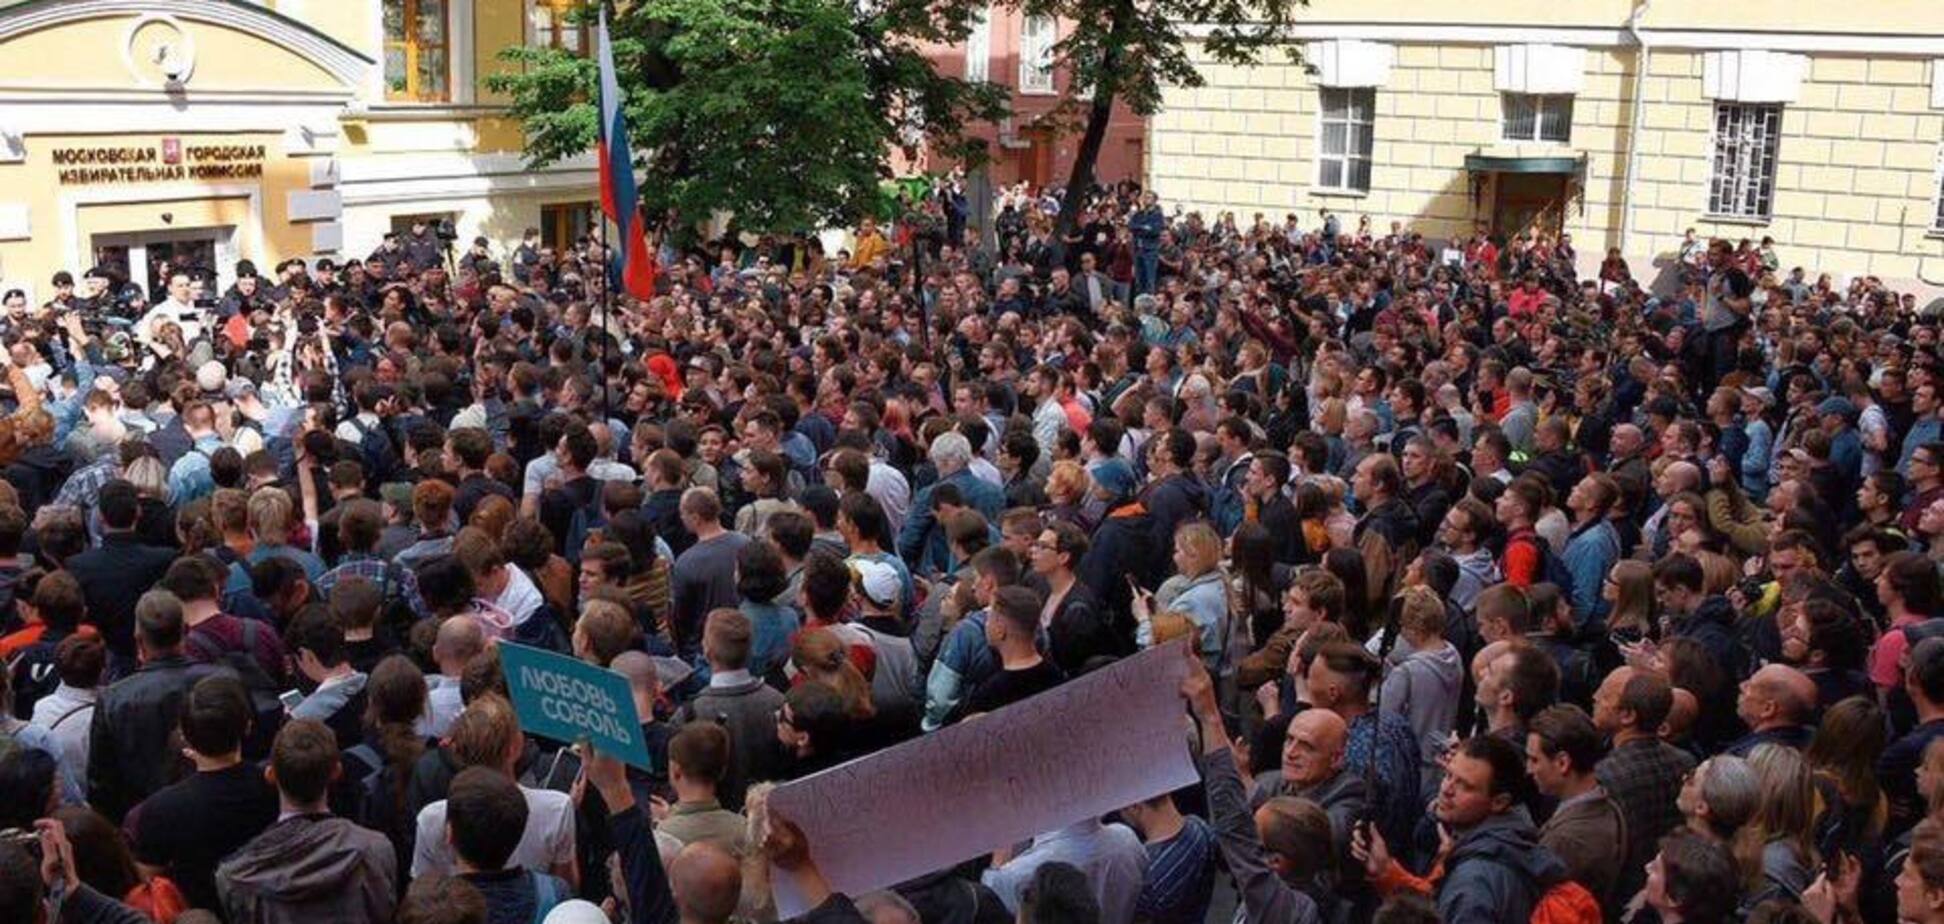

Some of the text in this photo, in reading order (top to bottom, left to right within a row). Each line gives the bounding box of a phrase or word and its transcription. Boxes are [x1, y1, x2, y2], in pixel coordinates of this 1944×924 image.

[52, 145, 266, 164] МОСКОВСКАЯ ГОРОДСКАЯ
[59, 163, 262, 185] ИЗБИРАТЕЛЬНАЯ КОМИССИЯ
[521, 666, 616, 714] ЛЮБОВЬ
[541, 697, 631, 745] СОБОЛЬ
